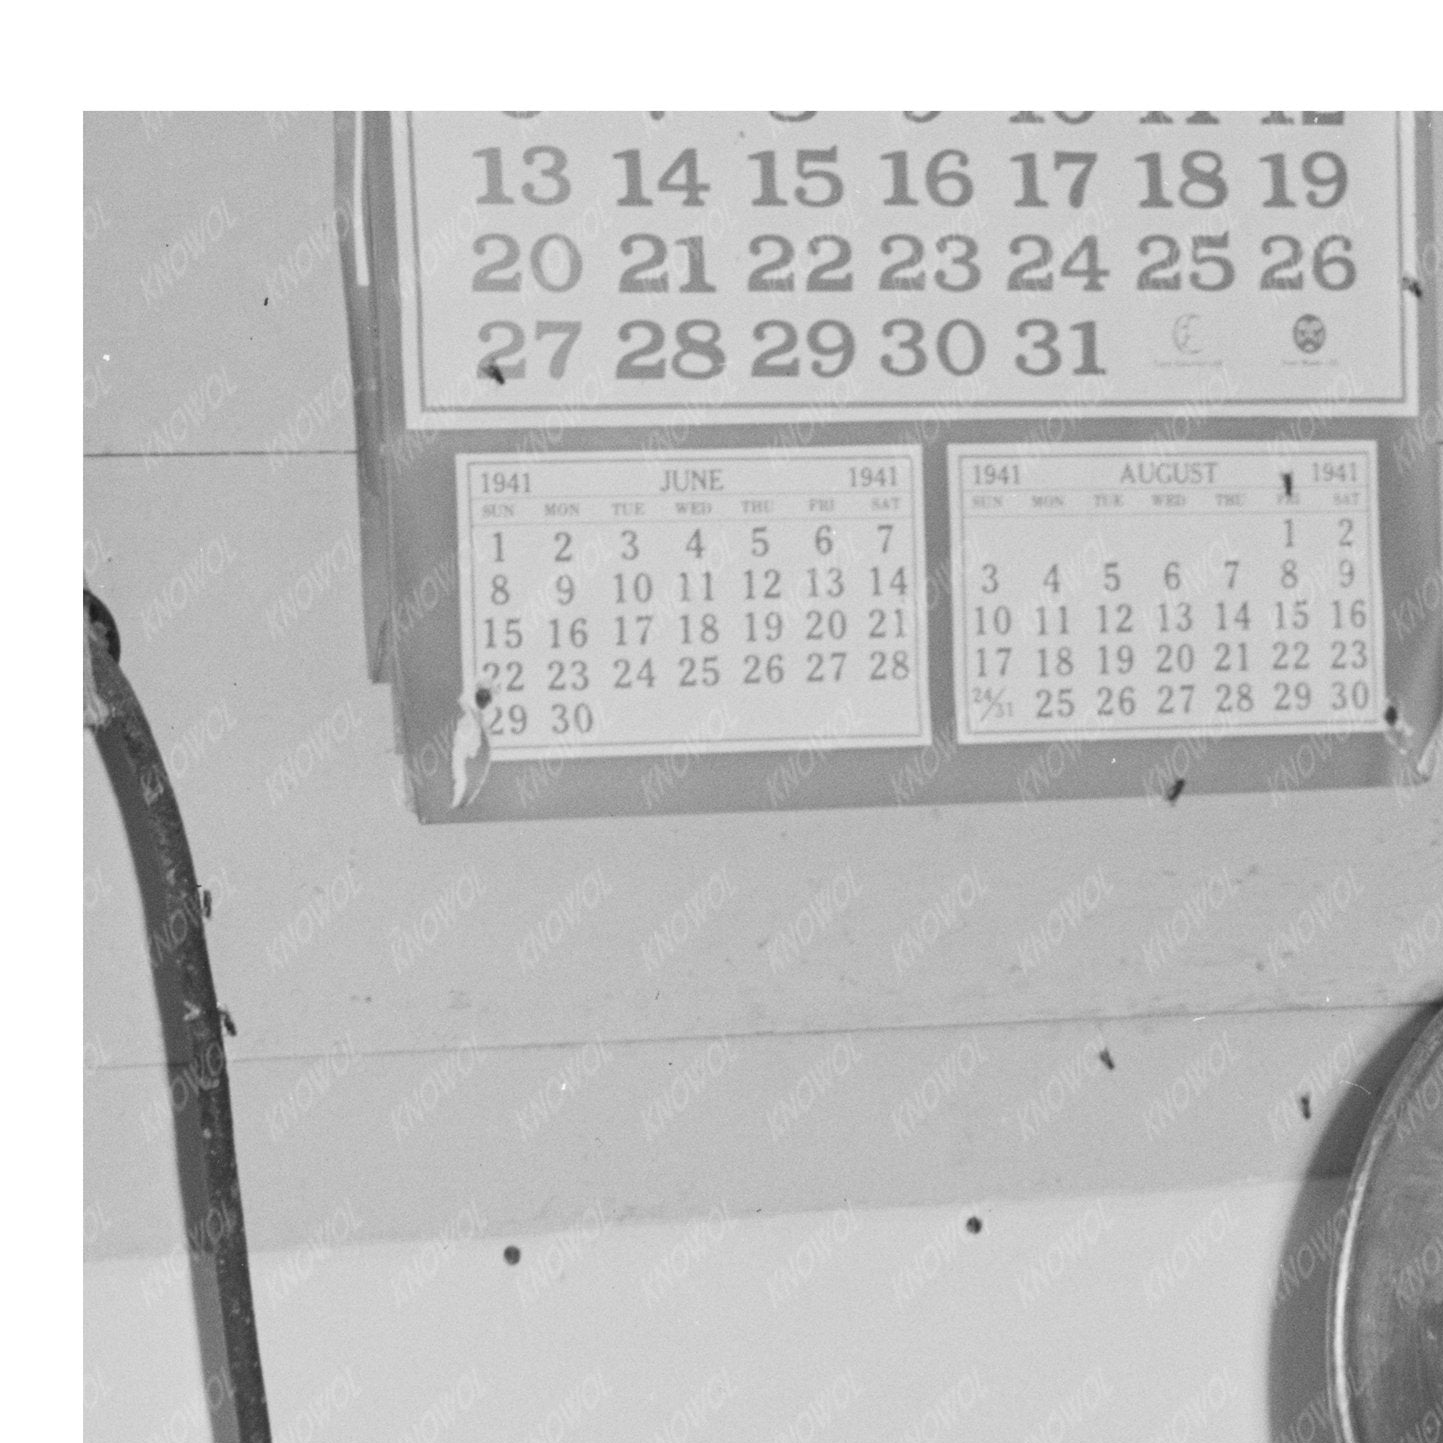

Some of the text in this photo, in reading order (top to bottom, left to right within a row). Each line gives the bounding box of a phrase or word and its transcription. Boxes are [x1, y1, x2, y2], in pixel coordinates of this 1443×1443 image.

[473, 145, 1348, 209] 13 14 15 16 17 18 19
[472, 231, 1357, 293] 20 21 22 23 24 25 26
[476, 318, 1106, 380] 27 28 29 30 31
[482, 466, 896, 493] 1941 JUNE 1941
[974, 461, 1357, 485] 1941 AUGUST 1941
[482, 497, 901, 518] SUN MON TUE WED THU FRI SAT
[493, 524, 893, 562] 1 2 3 4 5 6 7
[1284, 518, 1354, 548] 1 2
[491, 566, 907, 606] 8 9 10 11 12 13 14
[981, 559, 1355, 594] 3 4 5 6 7 8 9
[485, 608, 904, 649] 15 16 17 18 19 20 21
[975, 599, 1367, 636] 10 11 12 13 14 15 16
[484, 651, 909, 691] 22 23 24 25 26 27 28
[977, 639, 1368, 678] 17 18 19 20 21 22 23
[1036, 688, 1075, 719] 25
[1097, 686, 1136, 716] 26
[1158, 684, 1195, 715] 27
[1216, 683, 1254, 713] 28
[1274, 682, 1312, 711] 29
[1331, 680, 1370, 710] 30
[488, 703, 594, 735] 29 30
